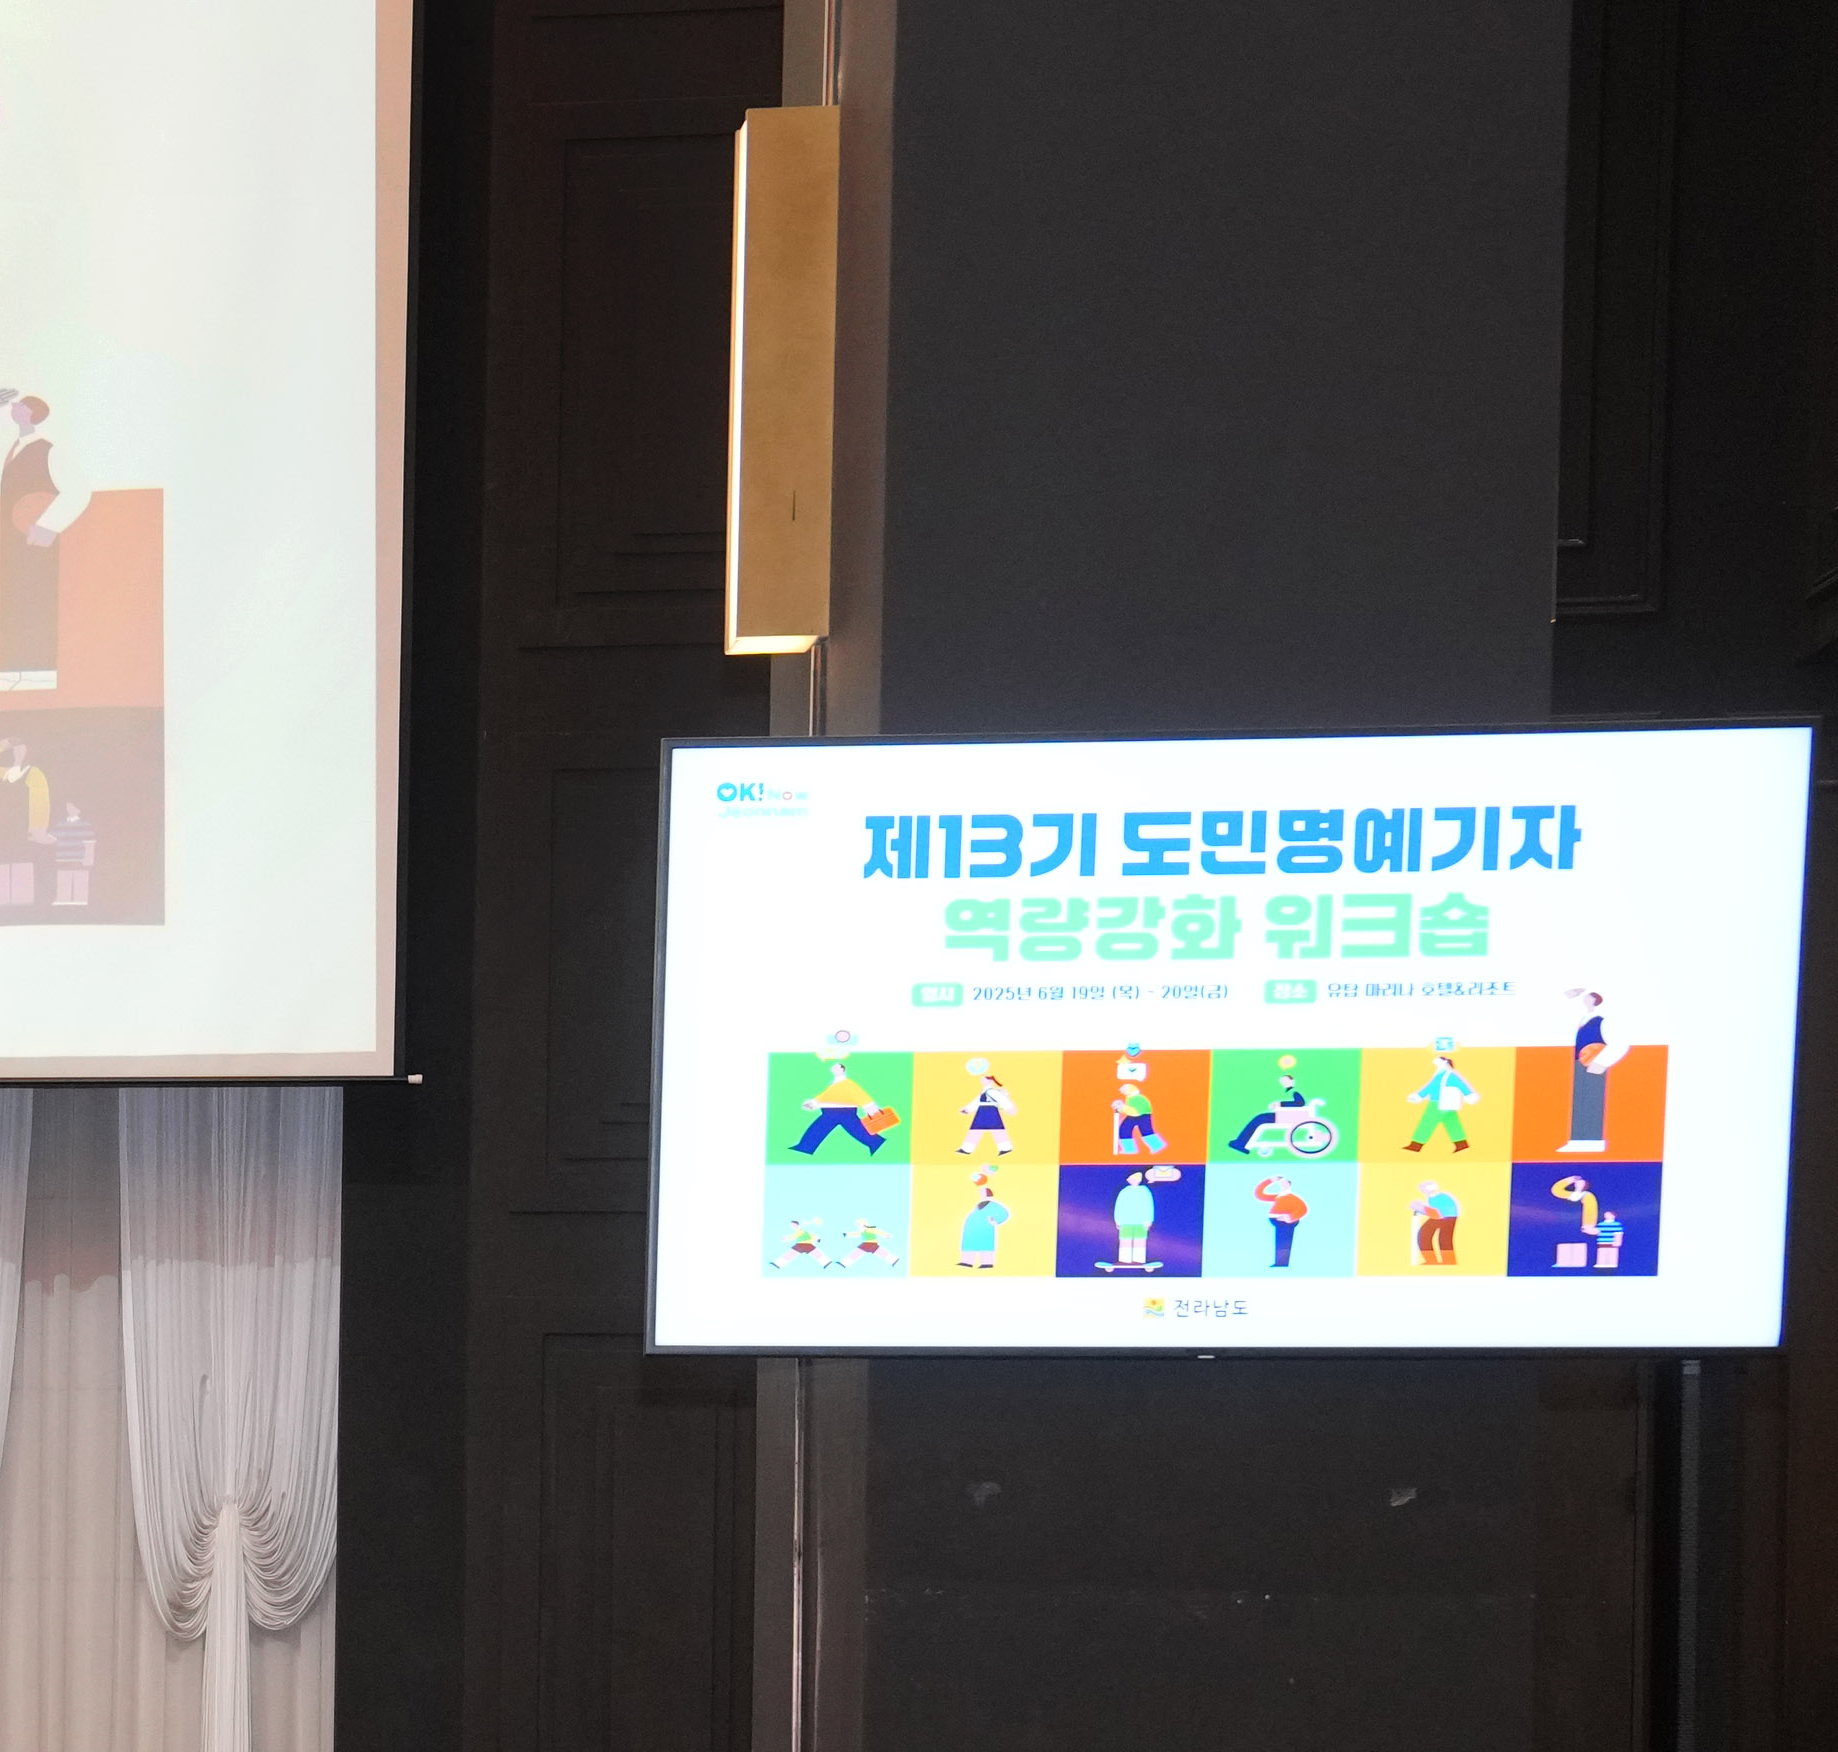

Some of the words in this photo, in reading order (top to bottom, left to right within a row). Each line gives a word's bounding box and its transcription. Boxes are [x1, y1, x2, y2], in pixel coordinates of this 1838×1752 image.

[717, 783, 764, 802] OK!
[864, 813, 1097, 879] 제13기
[1122, 805, 1581, 876] 도민명예기자
[945, 894, 1242, 961] 역량강화
[1266, 893, 1489, 959] 워크숍
[974, 987, 1031, 1000] 2025년
[1039, 987, 1063, 1000] 6월
[1073, 986, 1104, 999] 19일
[1113, 986, 1139, 999] (목)
[1162, 985, 1227, 999] 20일(금)
[1328, 984, 1358, 997] 유탑
[1366, 984, 1413, 996] 마리나
[1422, 981, 1516, 996] 호텔&리조트
[1176, 1300, 1248, 1317] 전라남도
